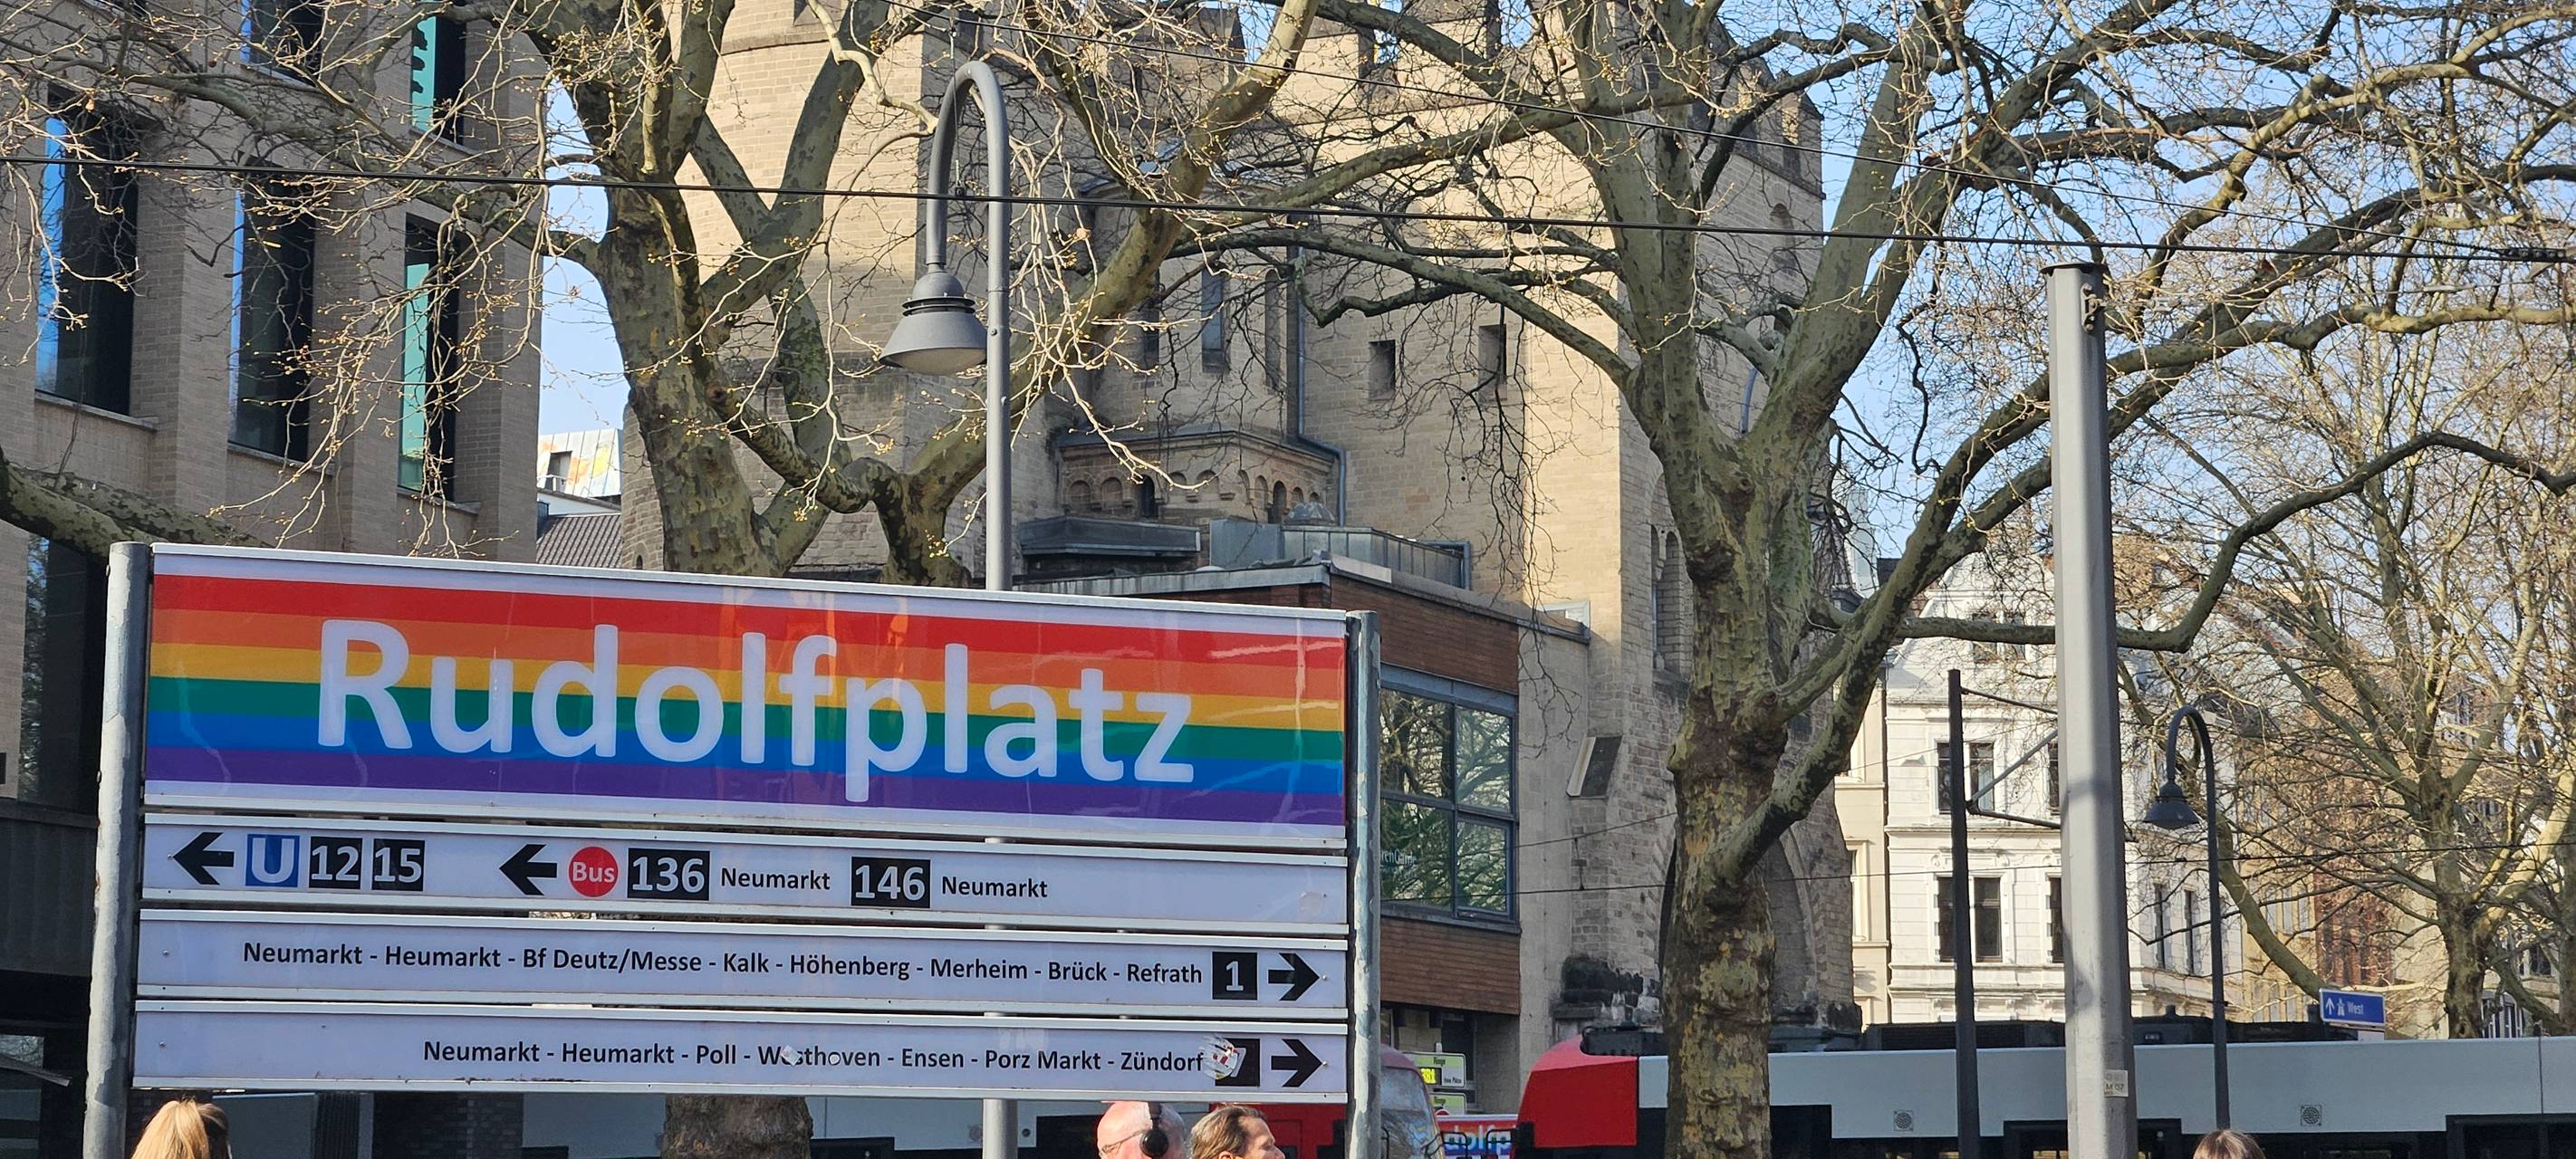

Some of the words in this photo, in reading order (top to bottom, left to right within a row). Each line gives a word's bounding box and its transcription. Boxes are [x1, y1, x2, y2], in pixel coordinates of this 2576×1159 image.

[317, 618, 1196, 803] Rudolfplatz
[251, 838, 294, 884] U
[311, 845, 360, 882] 12
[373, 847, 423, 884] 15
[572, 861, 616, 884] Bus
[631, 857, 706, 894] 136
[720, 867, 831, 891] Neumarkt
[854, 864, 926, 902] 146
[942, 876, 1048, 898] Neumarkt
[243, 942, 363, 966] Neumarkt
[385, 944, 502, 968] Heumarkt
[523, 947, 548, 970] Bf
[553, 948, 702, 974] Deutz/Messe
[724, 951, 770, 973] Kalk
[790, 953, 910, 982] Höhenberg
[930, 957, 1028, 981] Merheim
[1048, 961, 1108, 982] Brück
[1127, 963, 1202, 984] Refrath
[1226, 961, 1244, 991] 1
[2346, 1001, 2365, 1015] West
[423, 1040, 540, 1063] Neumarkt
[561, 1042, 675, 1065] Heumarkt
[696, 1043, 736, 1065] Poll
[901, 1048, 964, 1068] Ensen
[985, 1049, 1031, 1070] Porz
[1037, 1049, 1101, 1070] Markt
[1120, 1050, 1205, 1072] Zündorf
